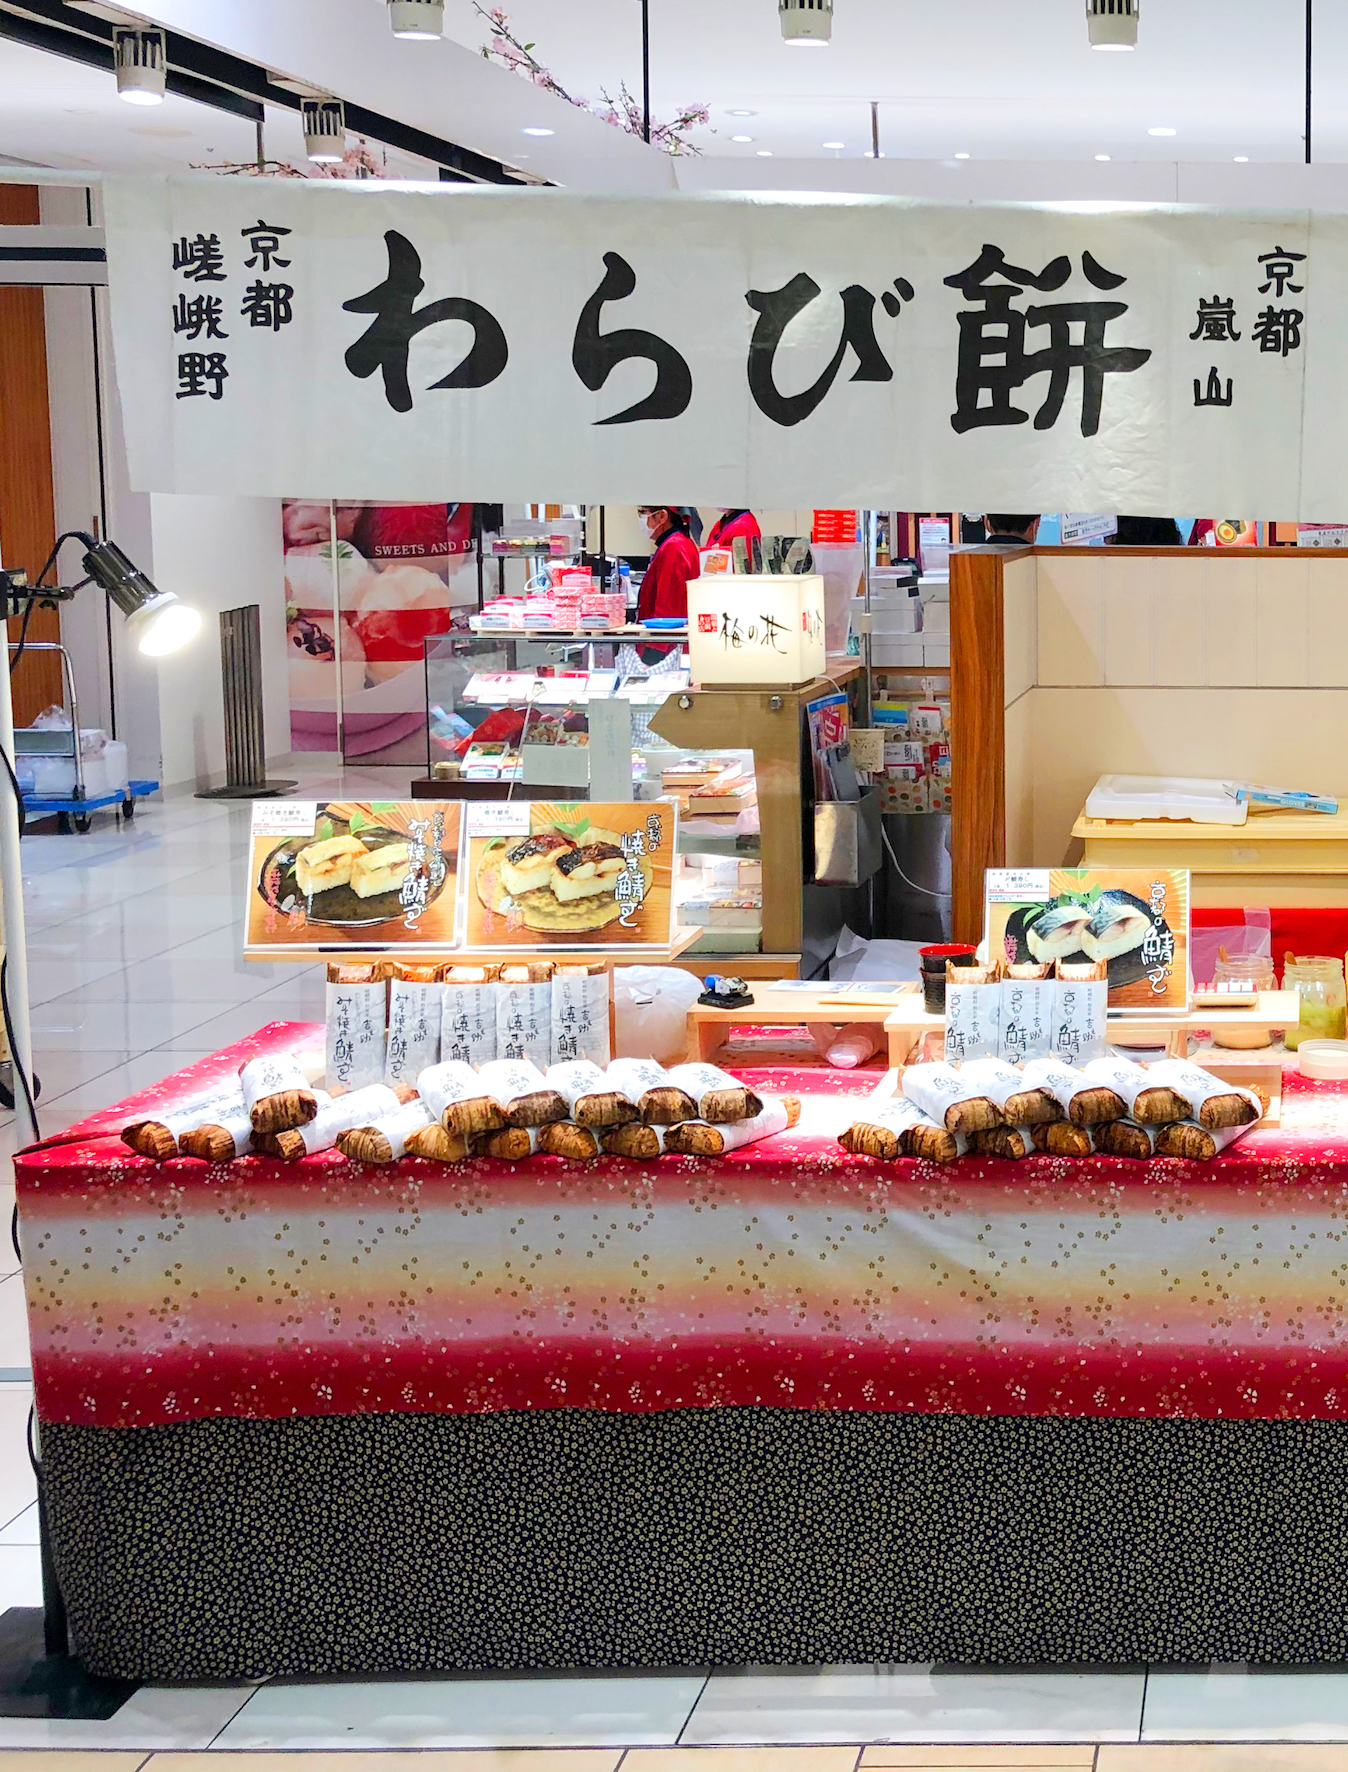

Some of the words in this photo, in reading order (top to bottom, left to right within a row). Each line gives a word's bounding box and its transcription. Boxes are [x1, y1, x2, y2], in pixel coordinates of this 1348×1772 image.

[172, 232, 230, 401] 嵯峨野
[241, 219, 293, 333] 京都
[1251, 245, 1307, 358] 京都
[343, 229, 1152, 437] わらび餅
[1189, 295, 1241, 408] 嵐山
[374, 543, 425, 556] SWEETS
[430, 541, 457, 554] AND
